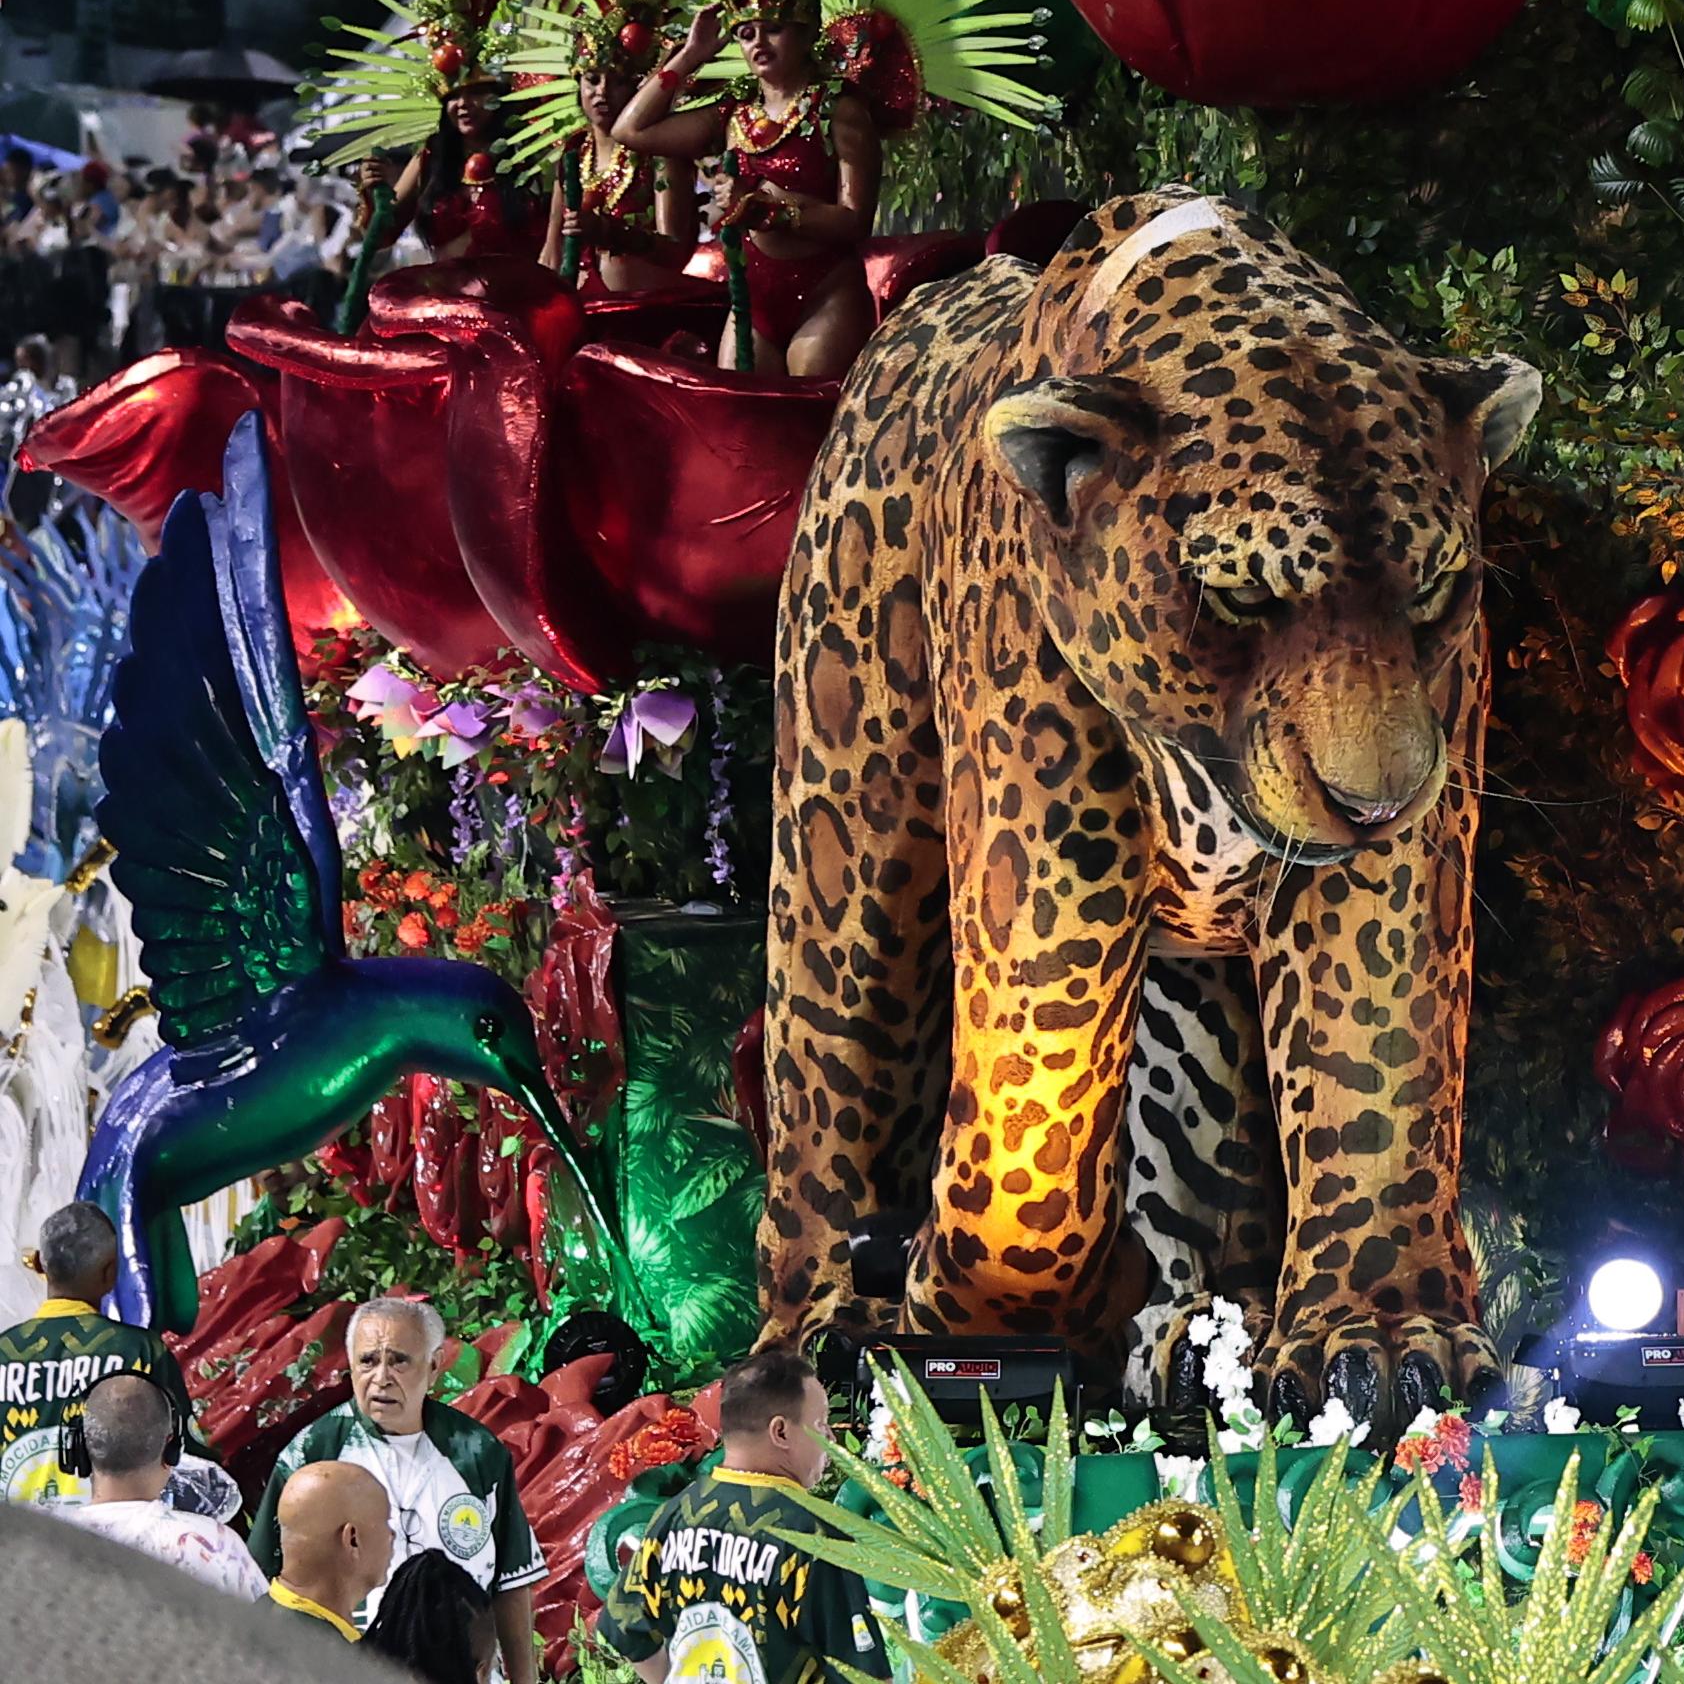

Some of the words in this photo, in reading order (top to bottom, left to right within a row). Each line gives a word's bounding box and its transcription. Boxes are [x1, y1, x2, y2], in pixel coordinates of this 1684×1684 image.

[1645, 1349, 1671, 1359] PRO
[929, 1362, 956, 1372] PRO
[661, 1527, 779, 1586] DIRETORIA
